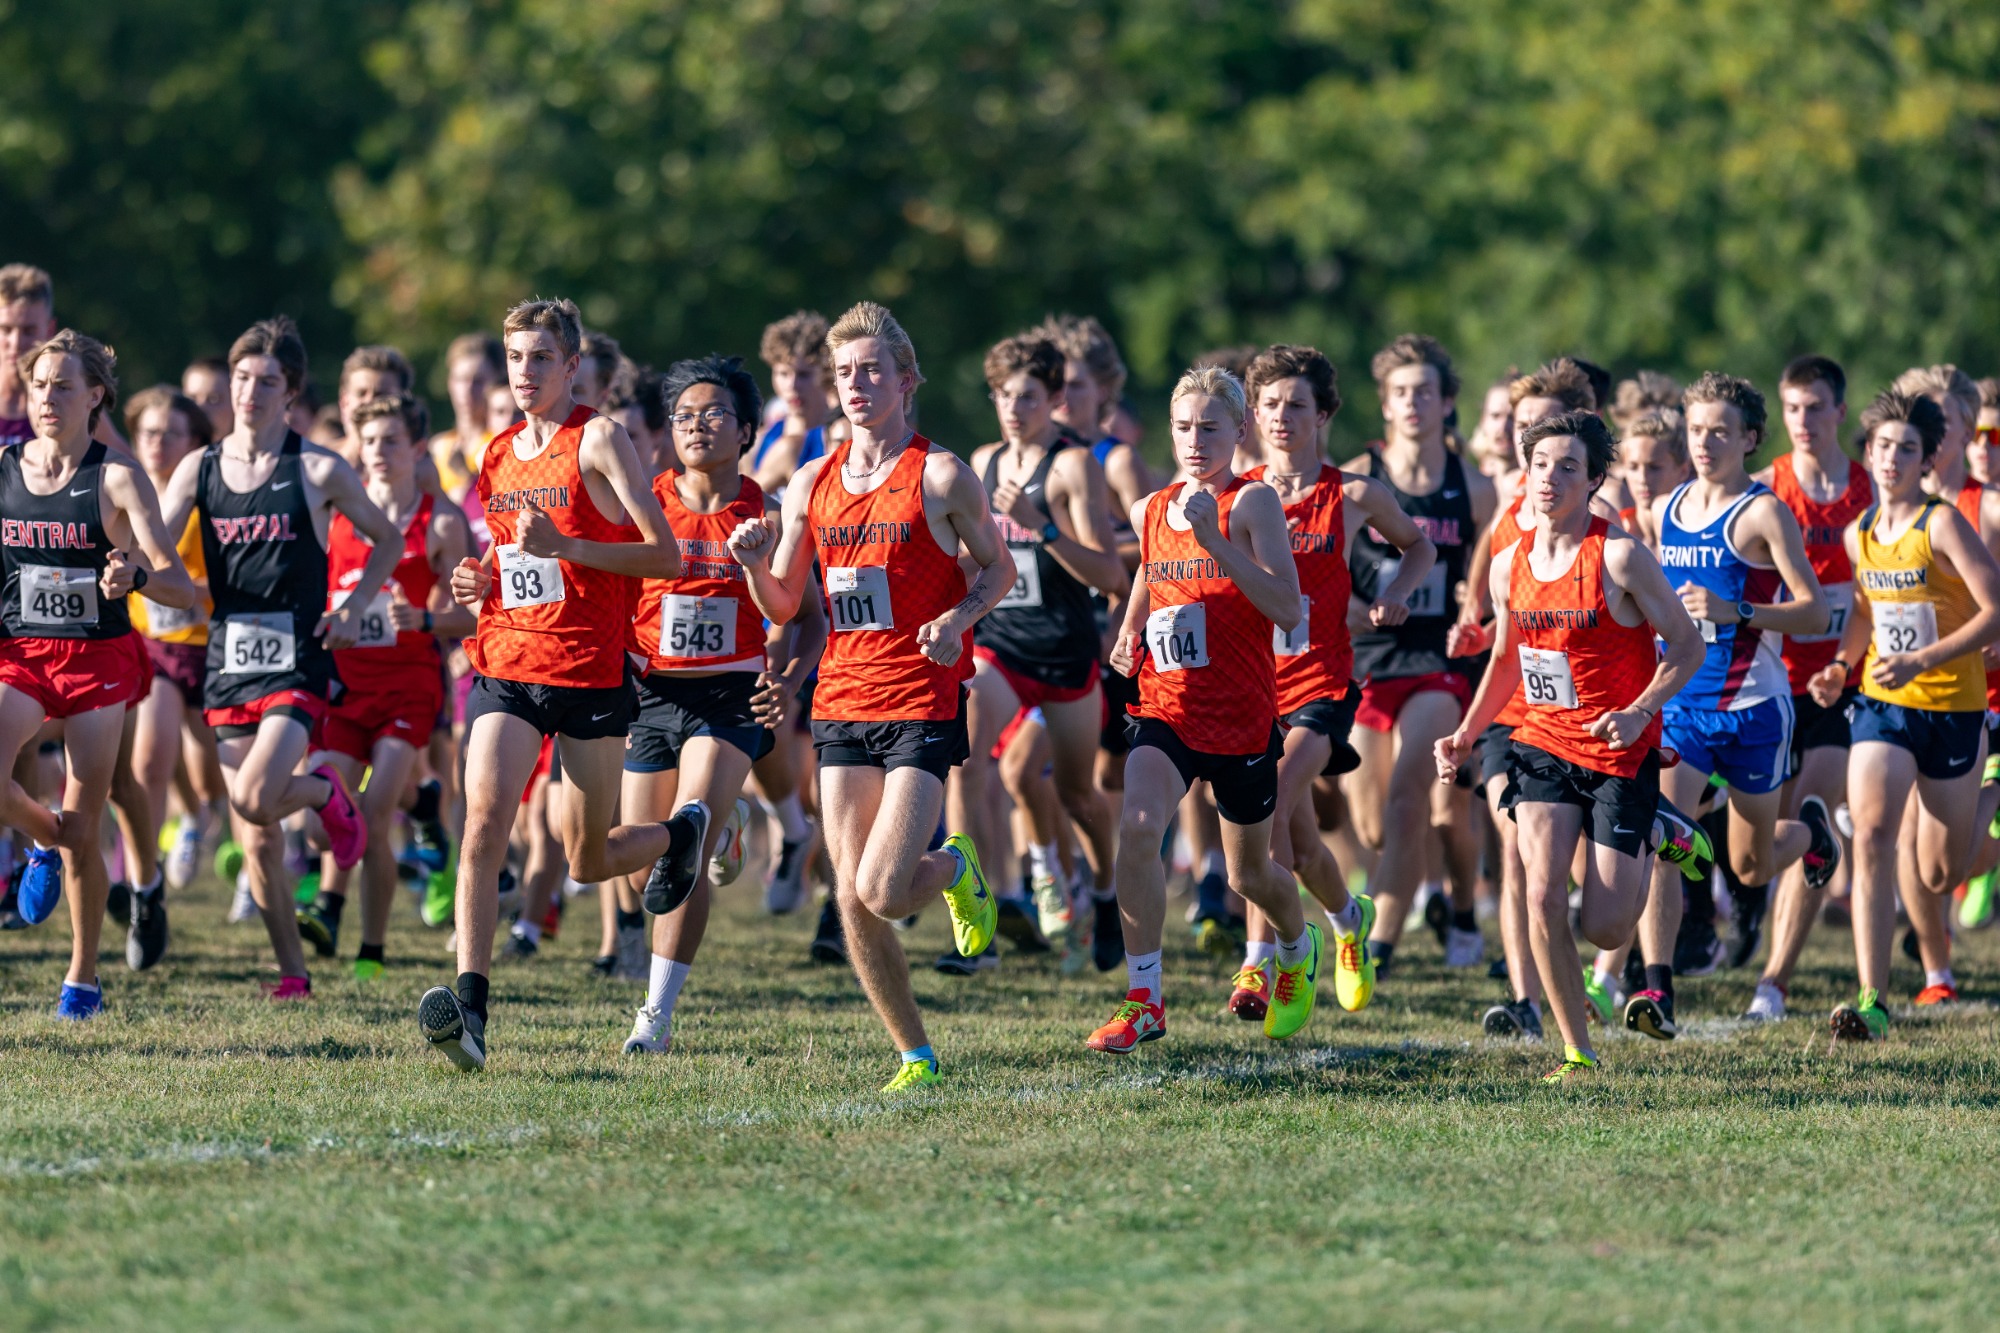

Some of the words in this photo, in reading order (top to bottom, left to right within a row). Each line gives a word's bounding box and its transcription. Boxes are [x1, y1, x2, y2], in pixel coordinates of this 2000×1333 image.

[679, 539, 731, 557] UMBOLD
[511, 569, 544, 600] 93
[693, 562, 744, 581] COUNTR
[33, 592, 85, 618] 489
[834, 594, 876, 625] 101
[670, 622, 724, 652] 543
[1156, 631, 1198, 665] 104
[1889, 627, 1919, 652] 32
[235, 639, 283, 666] 542
[1528, 673, 1557, 701] 95
